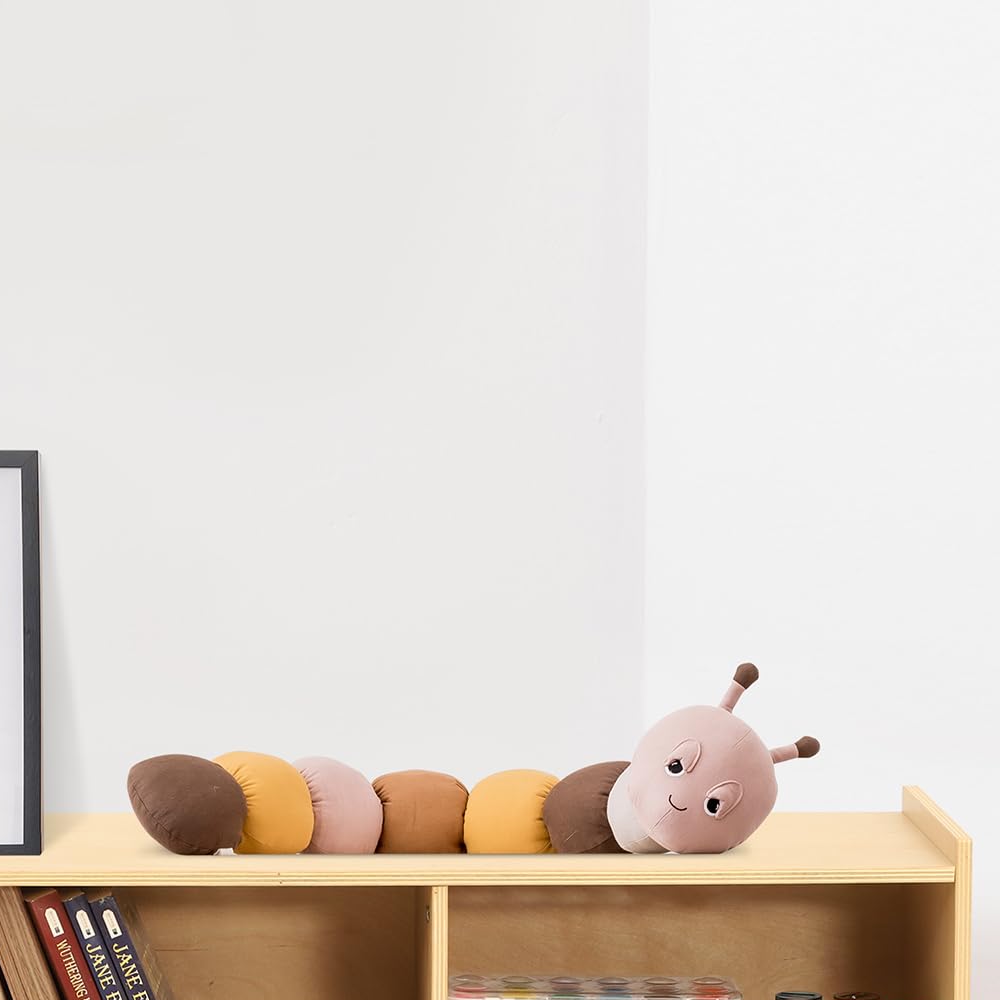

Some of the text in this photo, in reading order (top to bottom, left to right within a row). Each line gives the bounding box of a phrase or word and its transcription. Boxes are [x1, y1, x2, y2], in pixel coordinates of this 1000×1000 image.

[57, 939, 84, 998] WUTHERING
[86, 943, 116, 990] JANE
[112, 942, 143, 990] JANE
